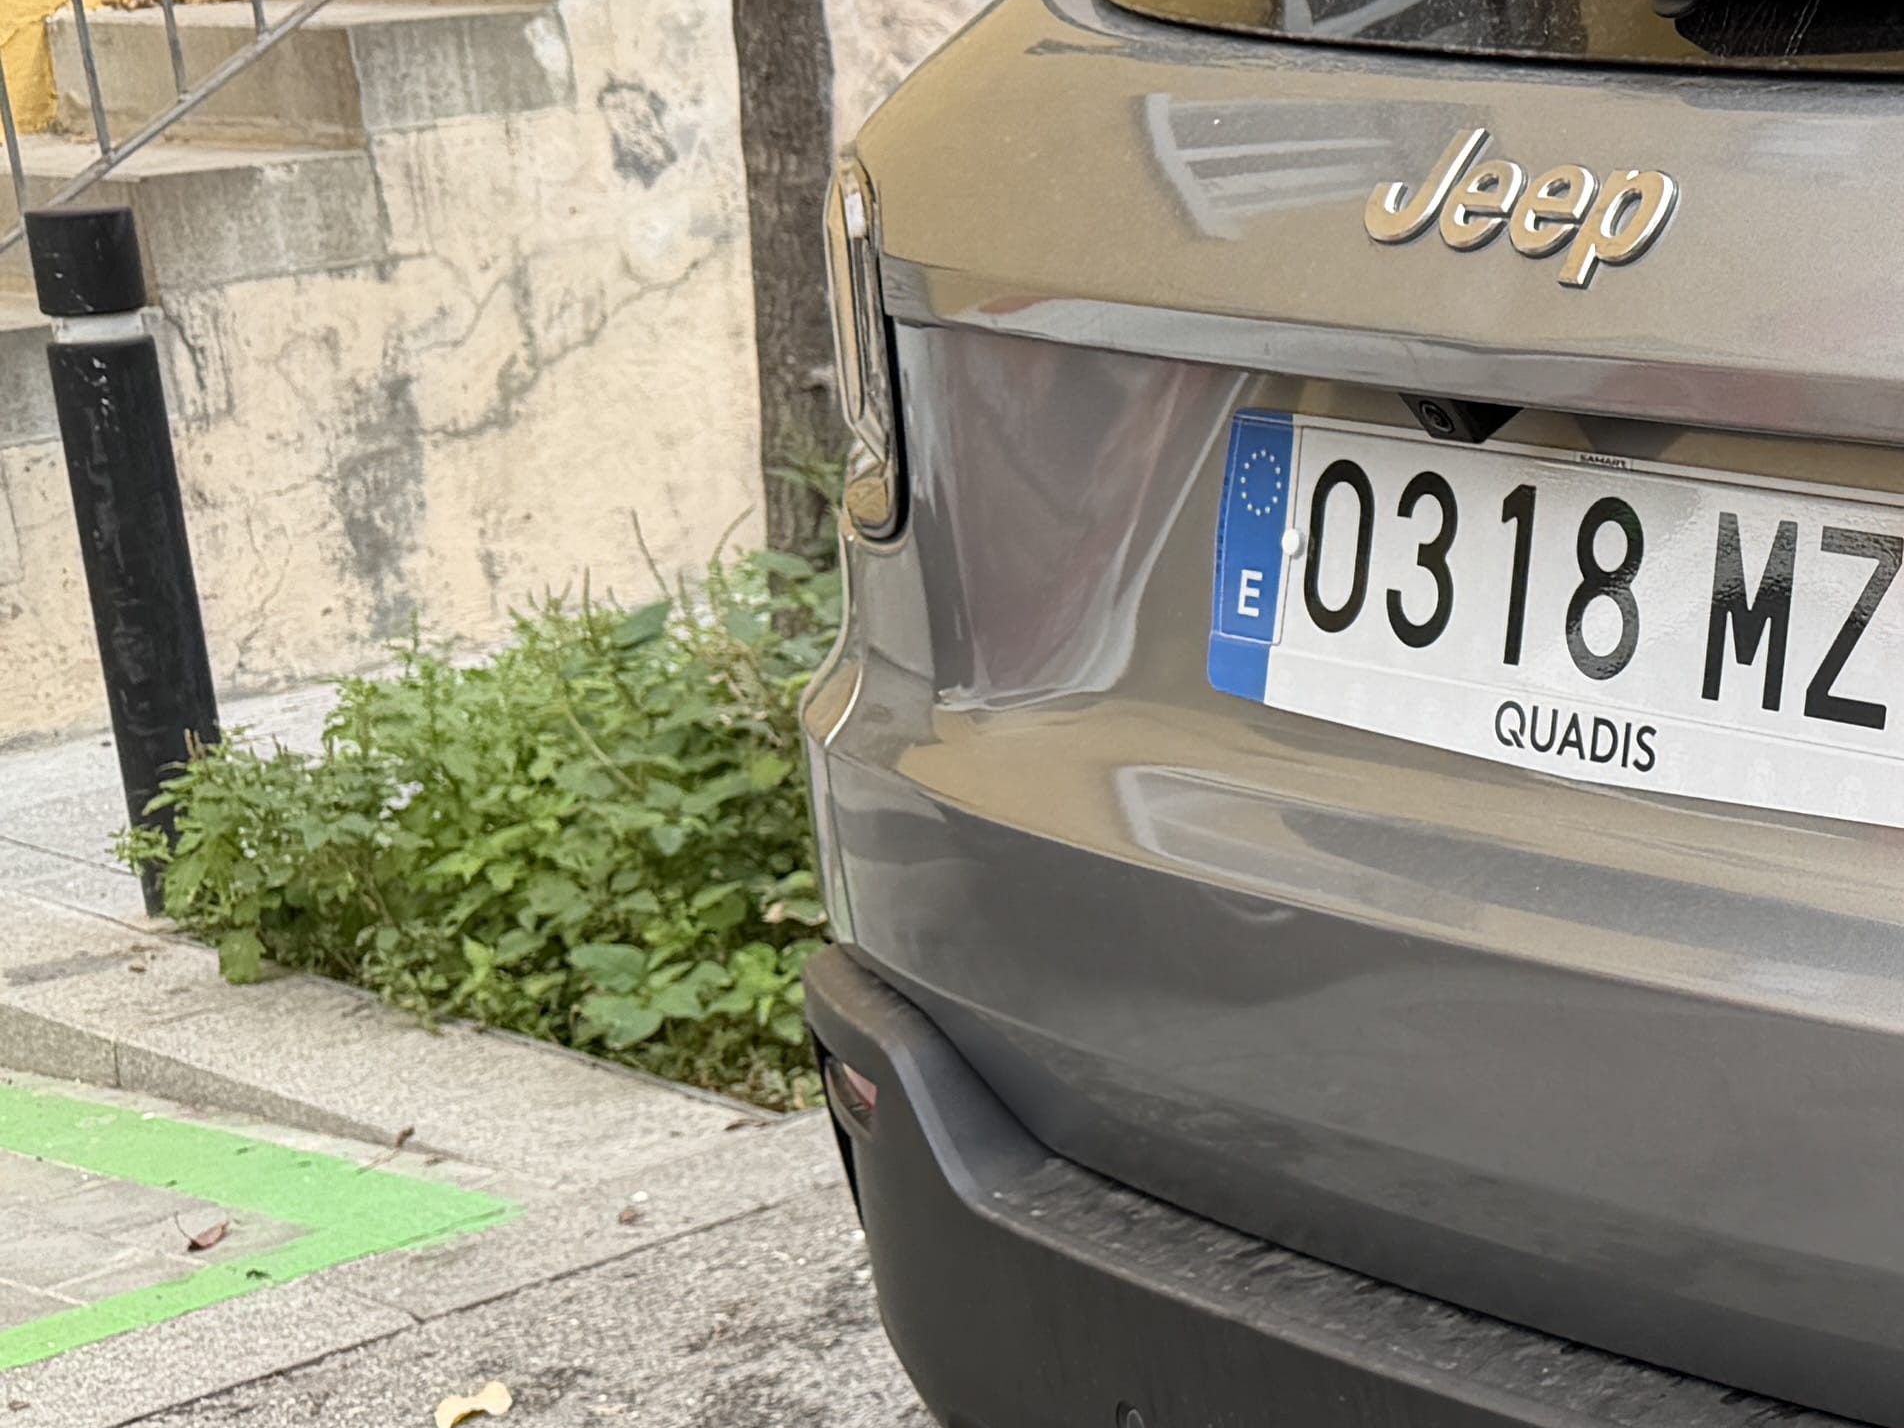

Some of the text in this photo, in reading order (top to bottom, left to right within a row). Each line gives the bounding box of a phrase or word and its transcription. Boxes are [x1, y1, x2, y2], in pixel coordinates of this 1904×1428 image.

[1364, 127, 1680, 290] Jeep
[1238, 569, 1263, 617] E
[1304, 459, 1644, 680] 0318
[1495, 700, 1657, 772] QUADIS
